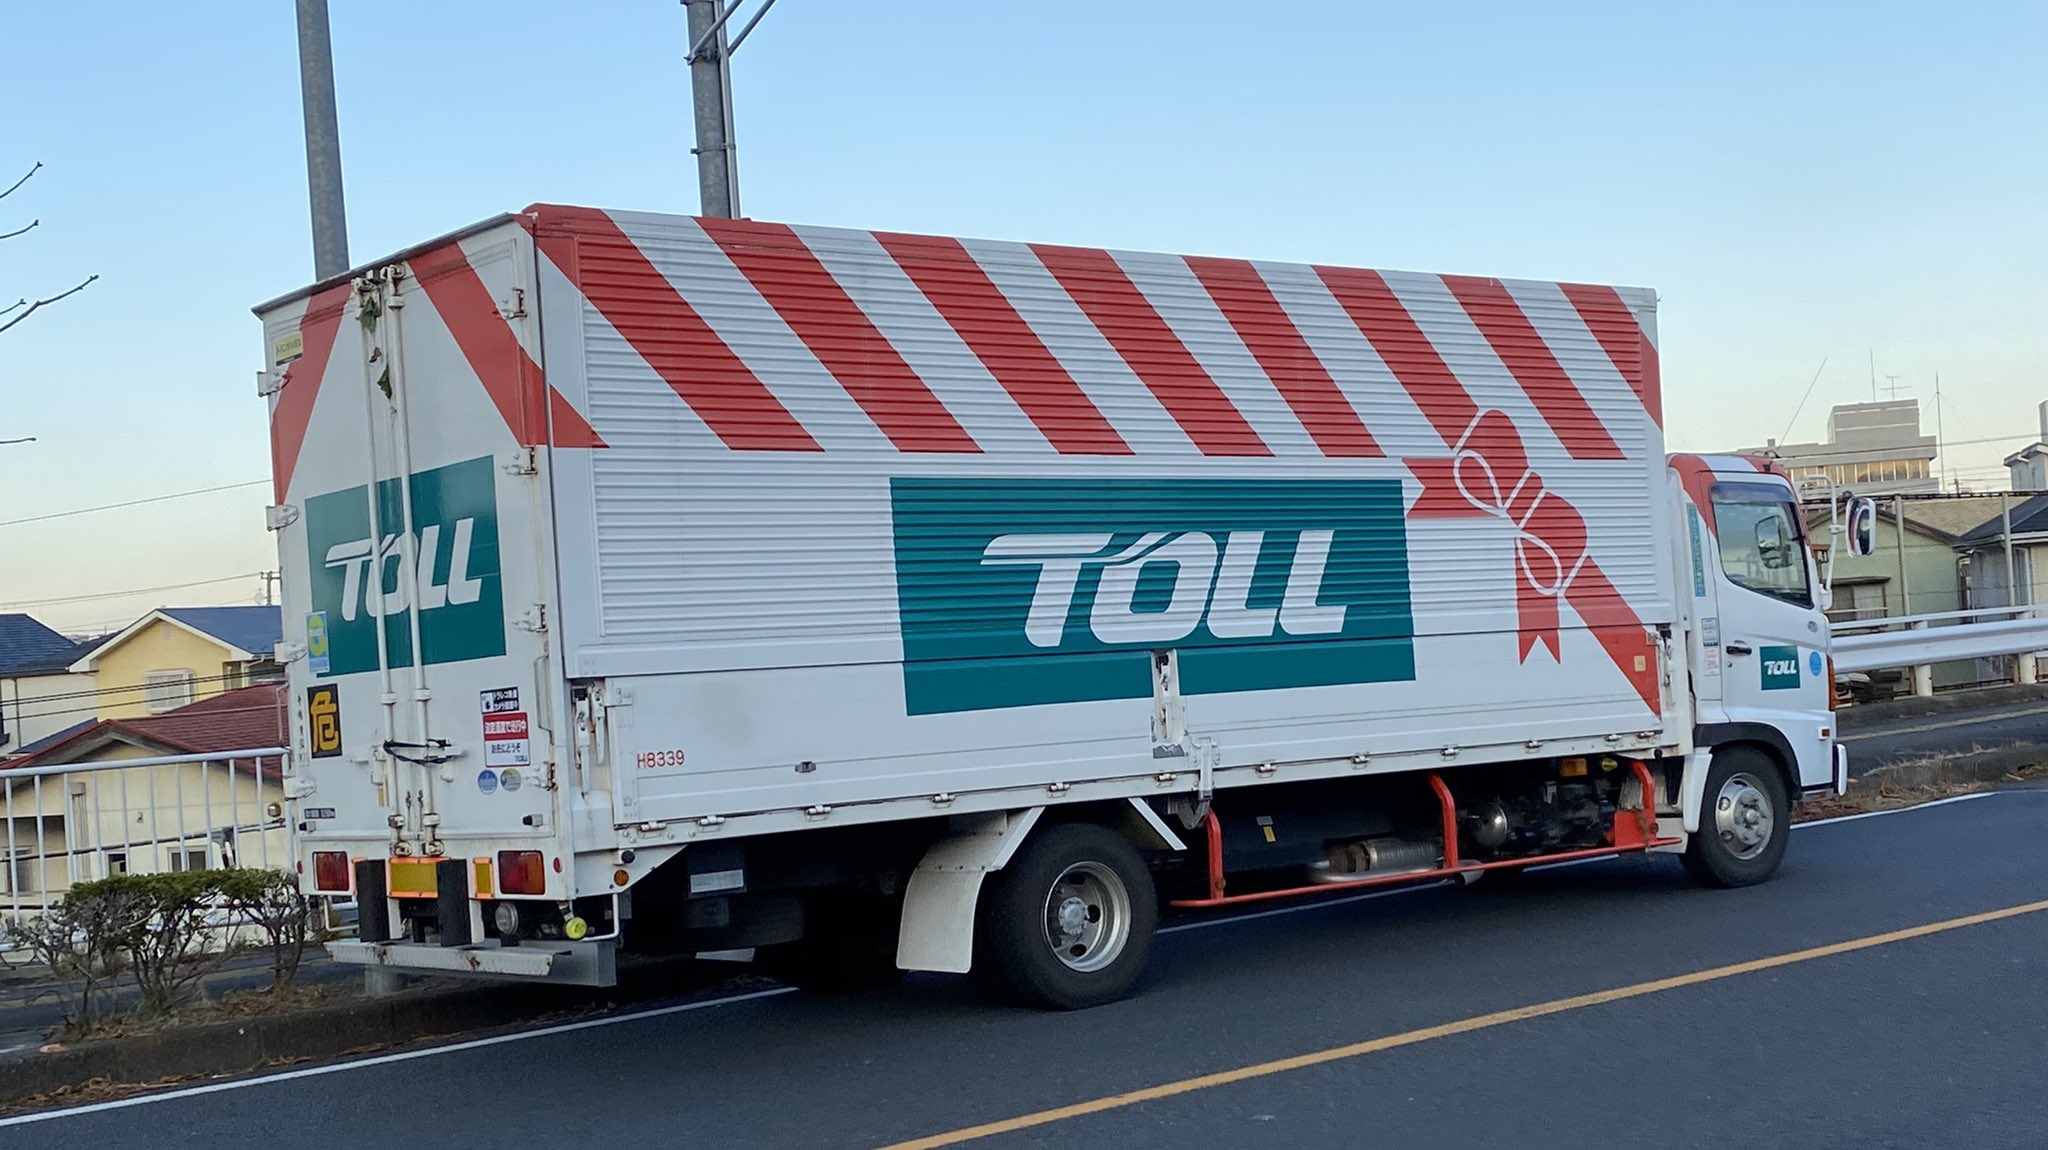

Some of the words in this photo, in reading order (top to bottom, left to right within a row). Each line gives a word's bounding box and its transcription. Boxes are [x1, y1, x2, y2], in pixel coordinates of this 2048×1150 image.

[325, 517, 482, 621] TOLL
[980, 529, 1348, 648] TOLL
[1764, 660, 1797, 675] TOLL
[310, 690, 339, 753] 危
[637, 750, 685, 769] H8339
